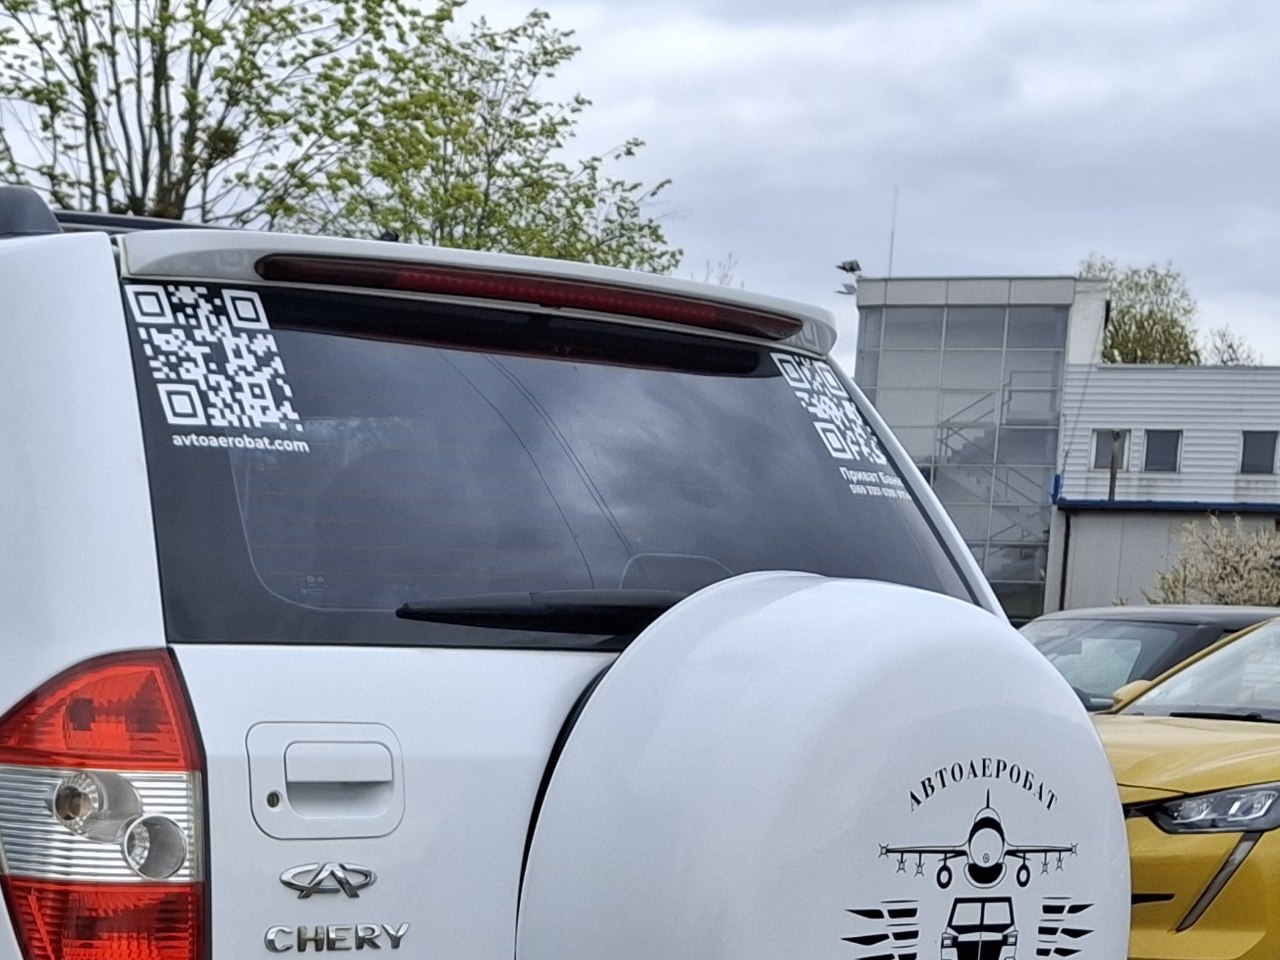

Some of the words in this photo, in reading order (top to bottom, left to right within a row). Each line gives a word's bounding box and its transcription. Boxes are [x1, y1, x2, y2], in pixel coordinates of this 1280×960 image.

[172, 433, 310, 453] avtoaerobat.com
[908, 757, 1058, 812] АВТОАЕРОБАТ
[264, 922, 411, 953] CHERY
